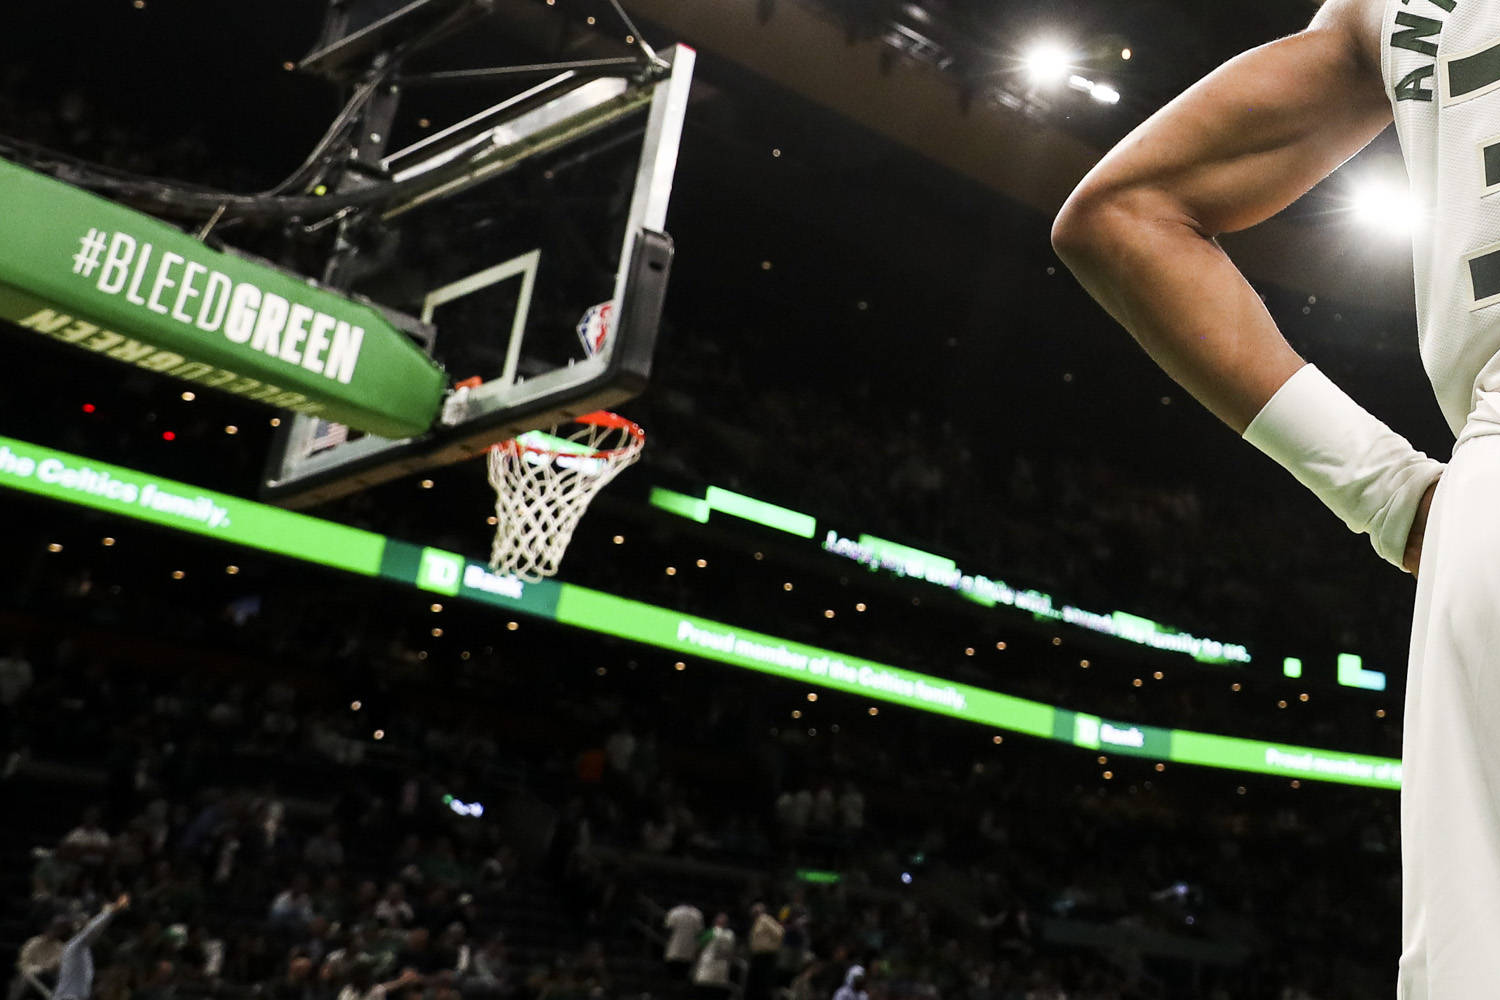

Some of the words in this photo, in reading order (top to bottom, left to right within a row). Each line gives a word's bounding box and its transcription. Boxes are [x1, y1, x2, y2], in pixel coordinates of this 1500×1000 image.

[72, 226, 366, 385] #BLEEDGREEN
[36, 458, 139, 503] Celtics
[140, 483, 231, 529] family.
[676, 620, 736, 653] Proud
[735, 639, 808, 670] member
[808, 656, 830, 676] of
[858, 666, 914, 698] Celtics
